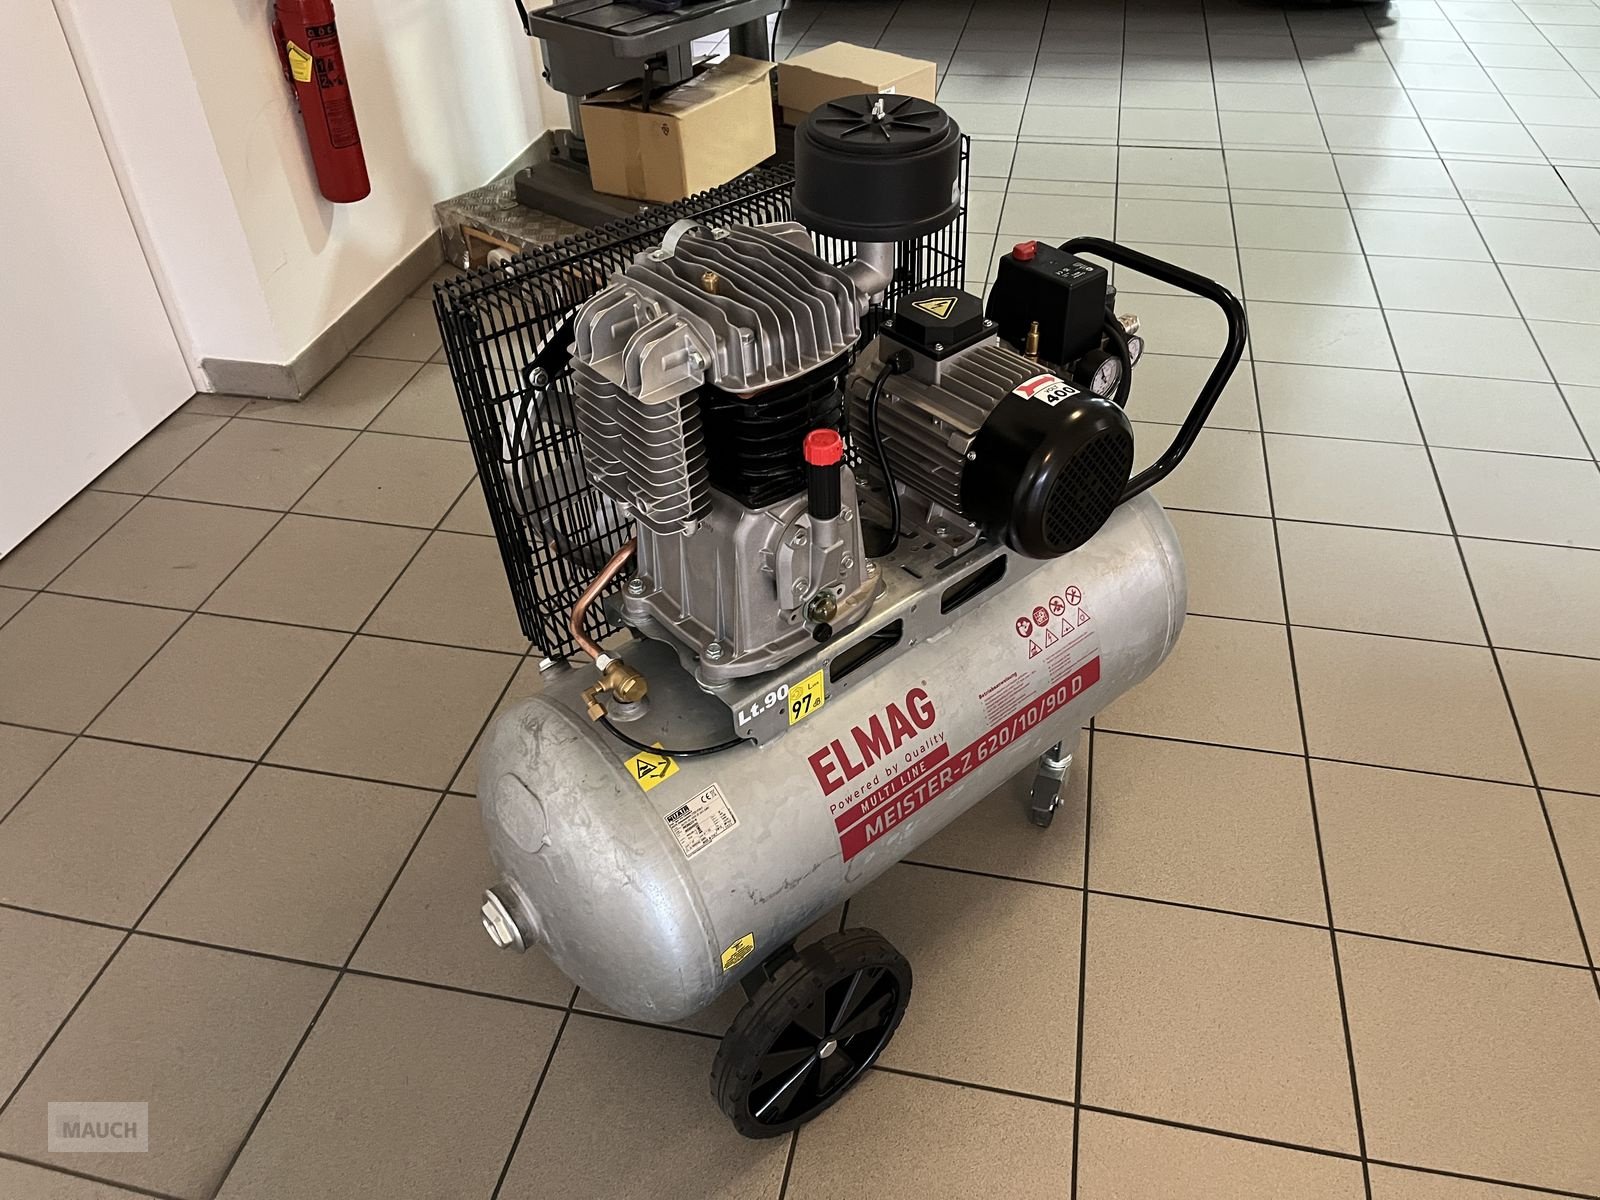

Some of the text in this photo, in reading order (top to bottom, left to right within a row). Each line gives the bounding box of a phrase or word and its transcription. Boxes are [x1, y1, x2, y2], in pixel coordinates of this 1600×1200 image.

[1047, 386, 1076, 402] 400
[738, 683, 789, 727] Lt.90
[792, 693, 812, 720] 97
[807, 687, 936, 797] ELMAG
[865, 751, 973, 842] MEISTER-Z
[977, 686, 1066, 761] 620/10/90
[1071, 675, 1082, 696] D
[829, 731, 945, 815] Powered by Quality
[860, 761, 927, 814] MULTI LINE
